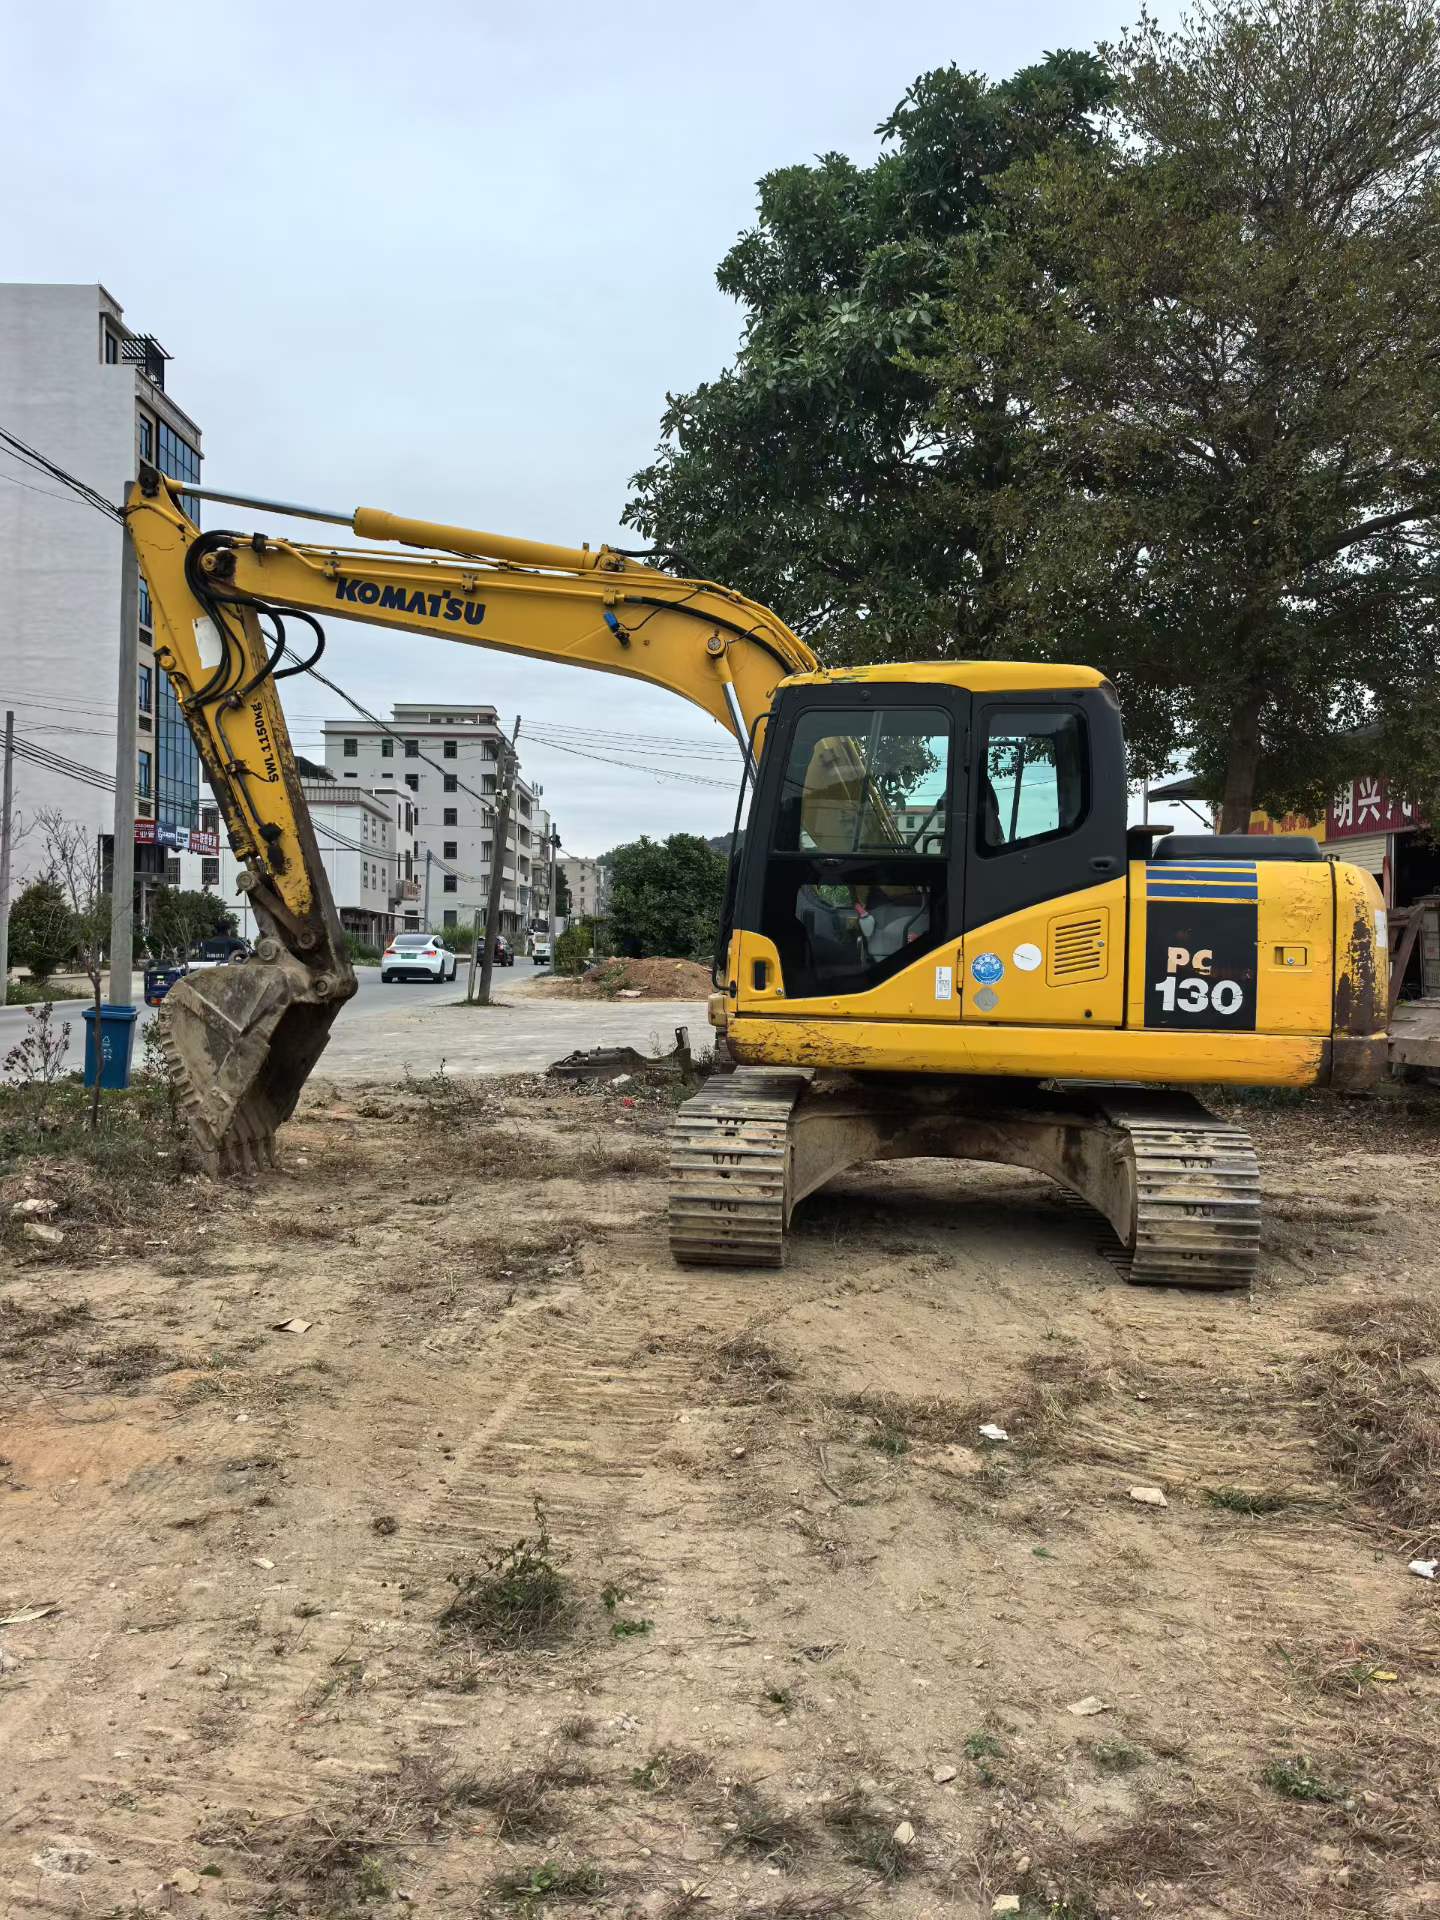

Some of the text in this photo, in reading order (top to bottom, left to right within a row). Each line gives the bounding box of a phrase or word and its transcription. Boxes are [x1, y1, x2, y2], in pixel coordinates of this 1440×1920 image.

[335, 576, 486, 625] KOMATSU
[264, 752, 279, 783] SWL
[1167, 946, 1213, 976] PC
[1155, 976, 1243, 1015] 130
